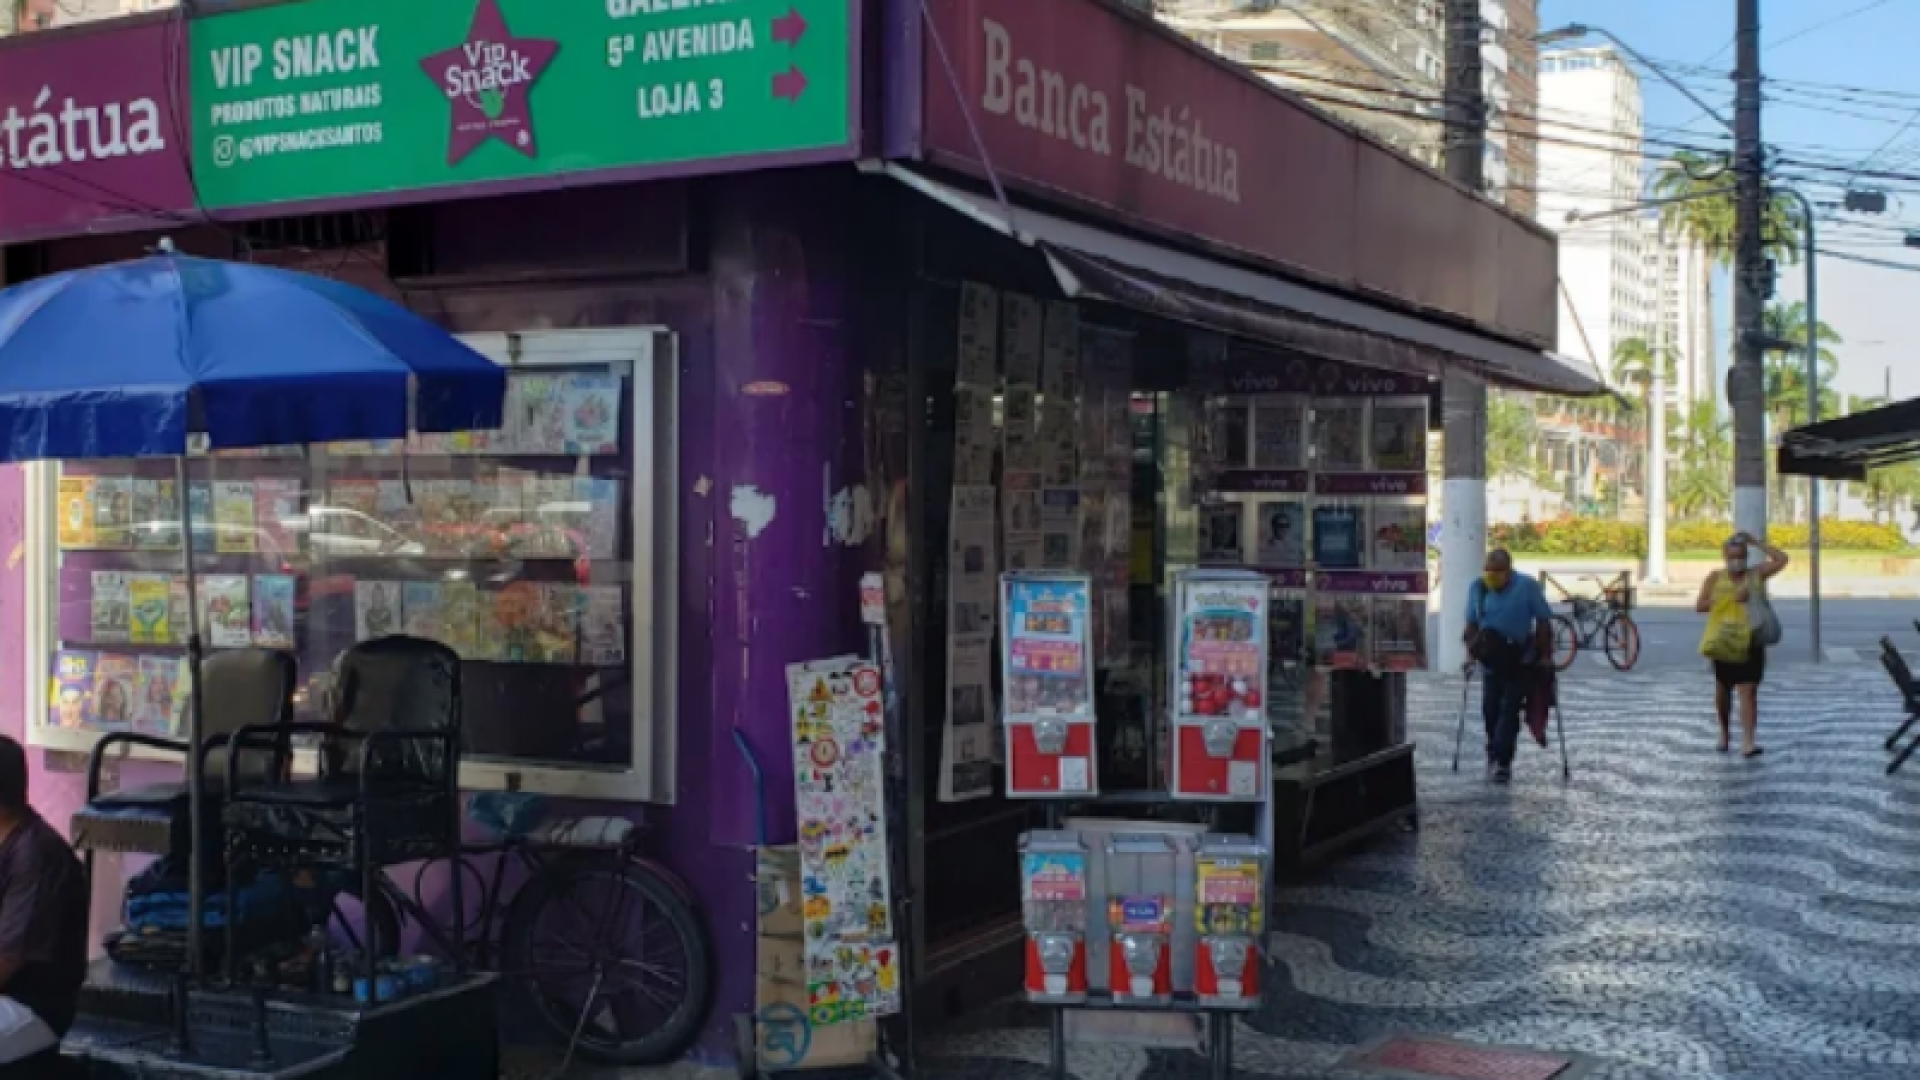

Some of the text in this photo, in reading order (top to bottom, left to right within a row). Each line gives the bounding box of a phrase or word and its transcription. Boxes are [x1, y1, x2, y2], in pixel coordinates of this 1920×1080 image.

[210, 25, 380, 89] VIP SNACK
[462, 40, 505, 67] Vip
[642, 18, 755, 63] AVENIDA
[445, 50, 531, 98] Snack
[211, 82, 382, 125] PRODUTOS NATURAIS
[638, 78, 724, 118] LOJA 3
[983, 18, 1240, 202] Banca Estátua
[0, 84, 165, 168] tátua
[1233, 373, 1278, 390] vivo
[1346, 373, 1396, 392] vivo
[1369, 475, 1407, 491] vivo
